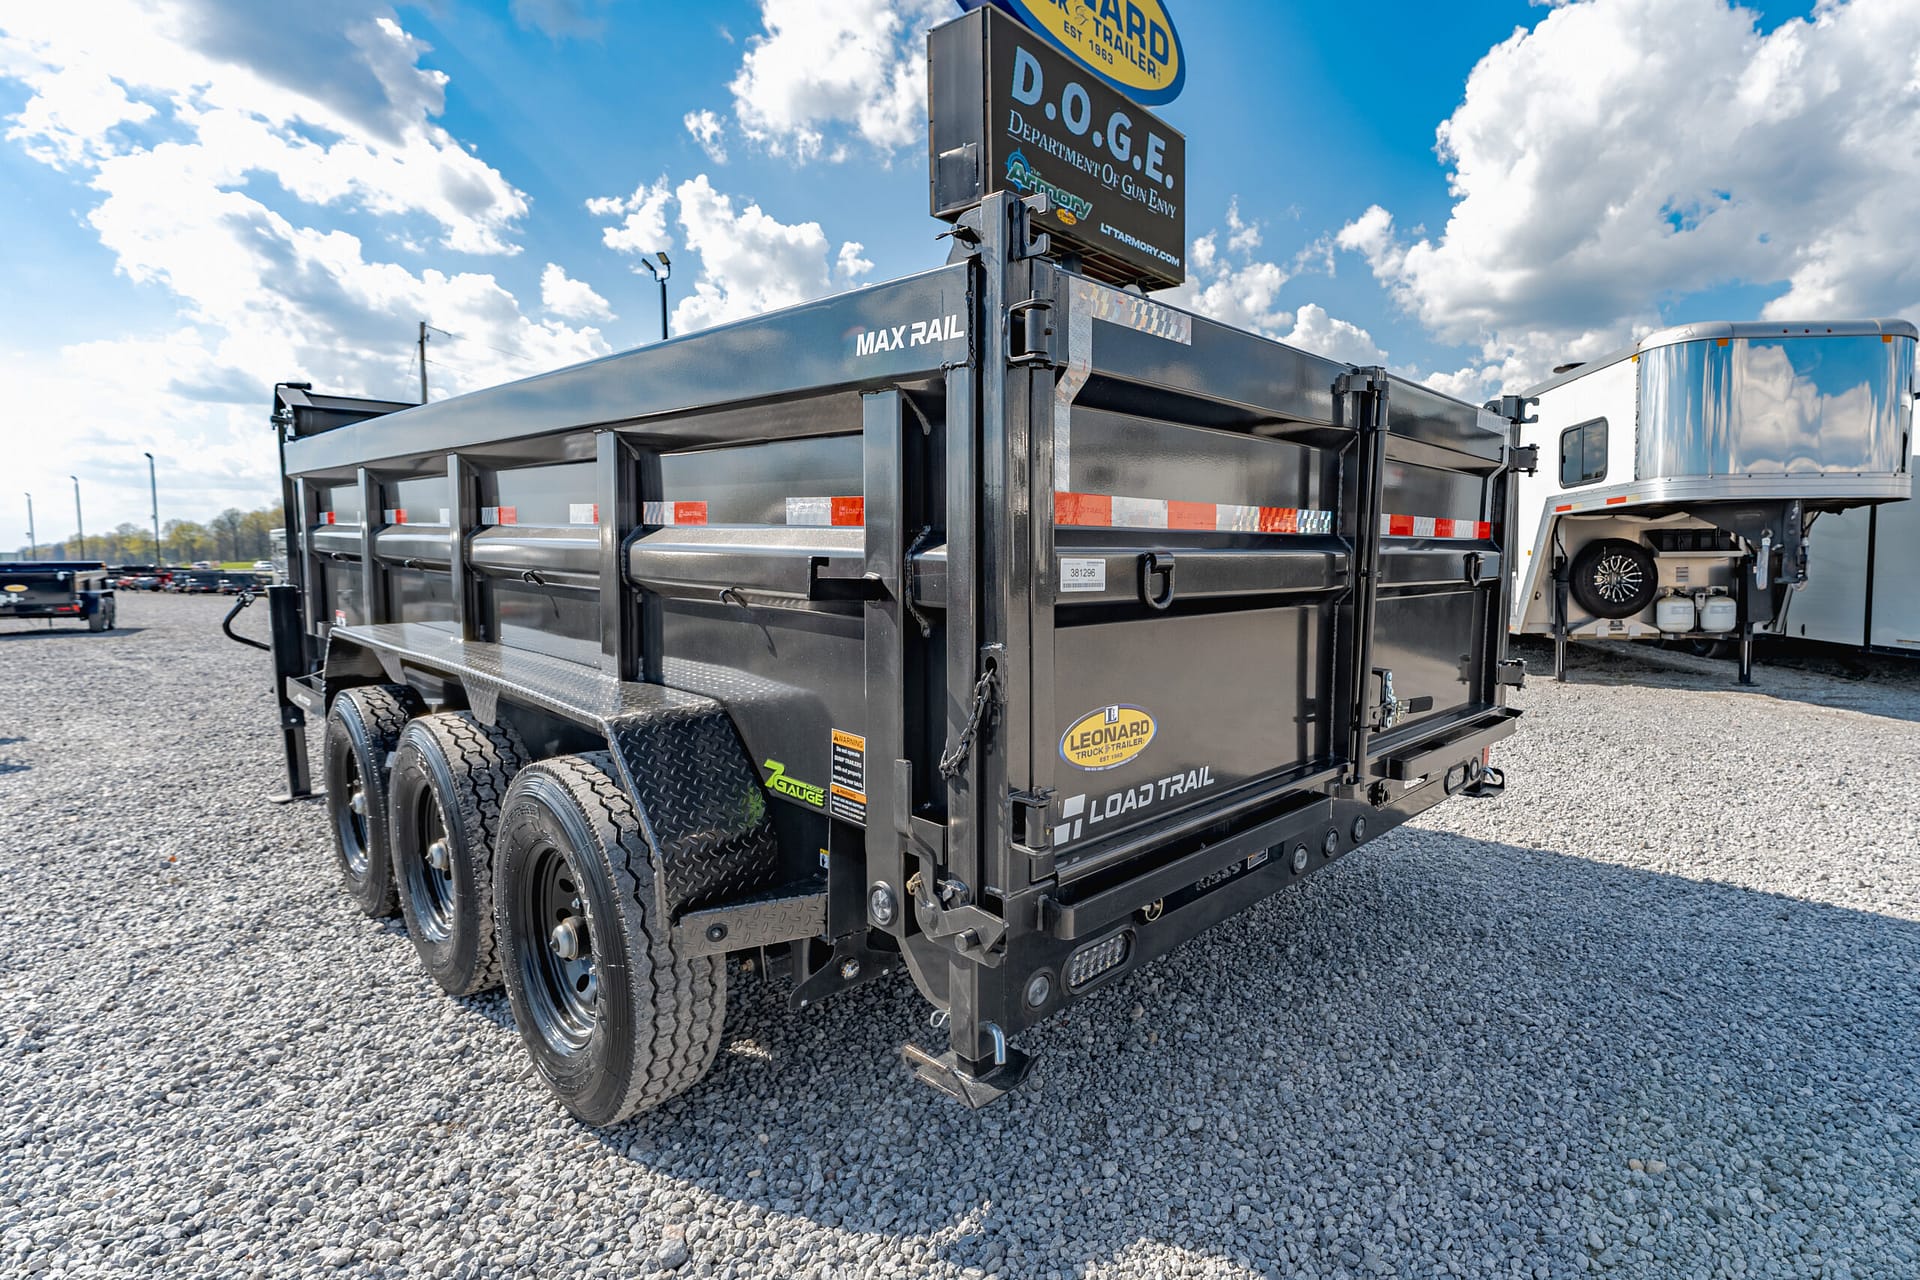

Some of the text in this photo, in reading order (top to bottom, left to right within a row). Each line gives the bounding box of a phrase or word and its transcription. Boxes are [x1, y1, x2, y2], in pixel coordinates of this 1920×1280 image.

[1063, 20, 1114, 65] EST 1963
[1093, 16, 1156, 79] TRAILER
[1011, 45, 1175, 191] D.O.G.E.
[1008, 109, 1101, 178] DEPARTMENT
[1121, 175, 1147, 204] GUN
[1147, 188, 1177, 219] ENVY
[1100, 222, 1180, 267] LTTARMORY.COM
[856, 314, 965, 357] MAX RAIL
[1070, 720, 1149, 751] LEONARD
[1076, 747, 1104, 760] TRUCK
[1110, 737, 1143, 751] TRAILER
[764, 759, 785, 788] 7
[773, 774, 824, 807] GAUGE
[1089, 765, 1215, 824] LOAD TRAIL
